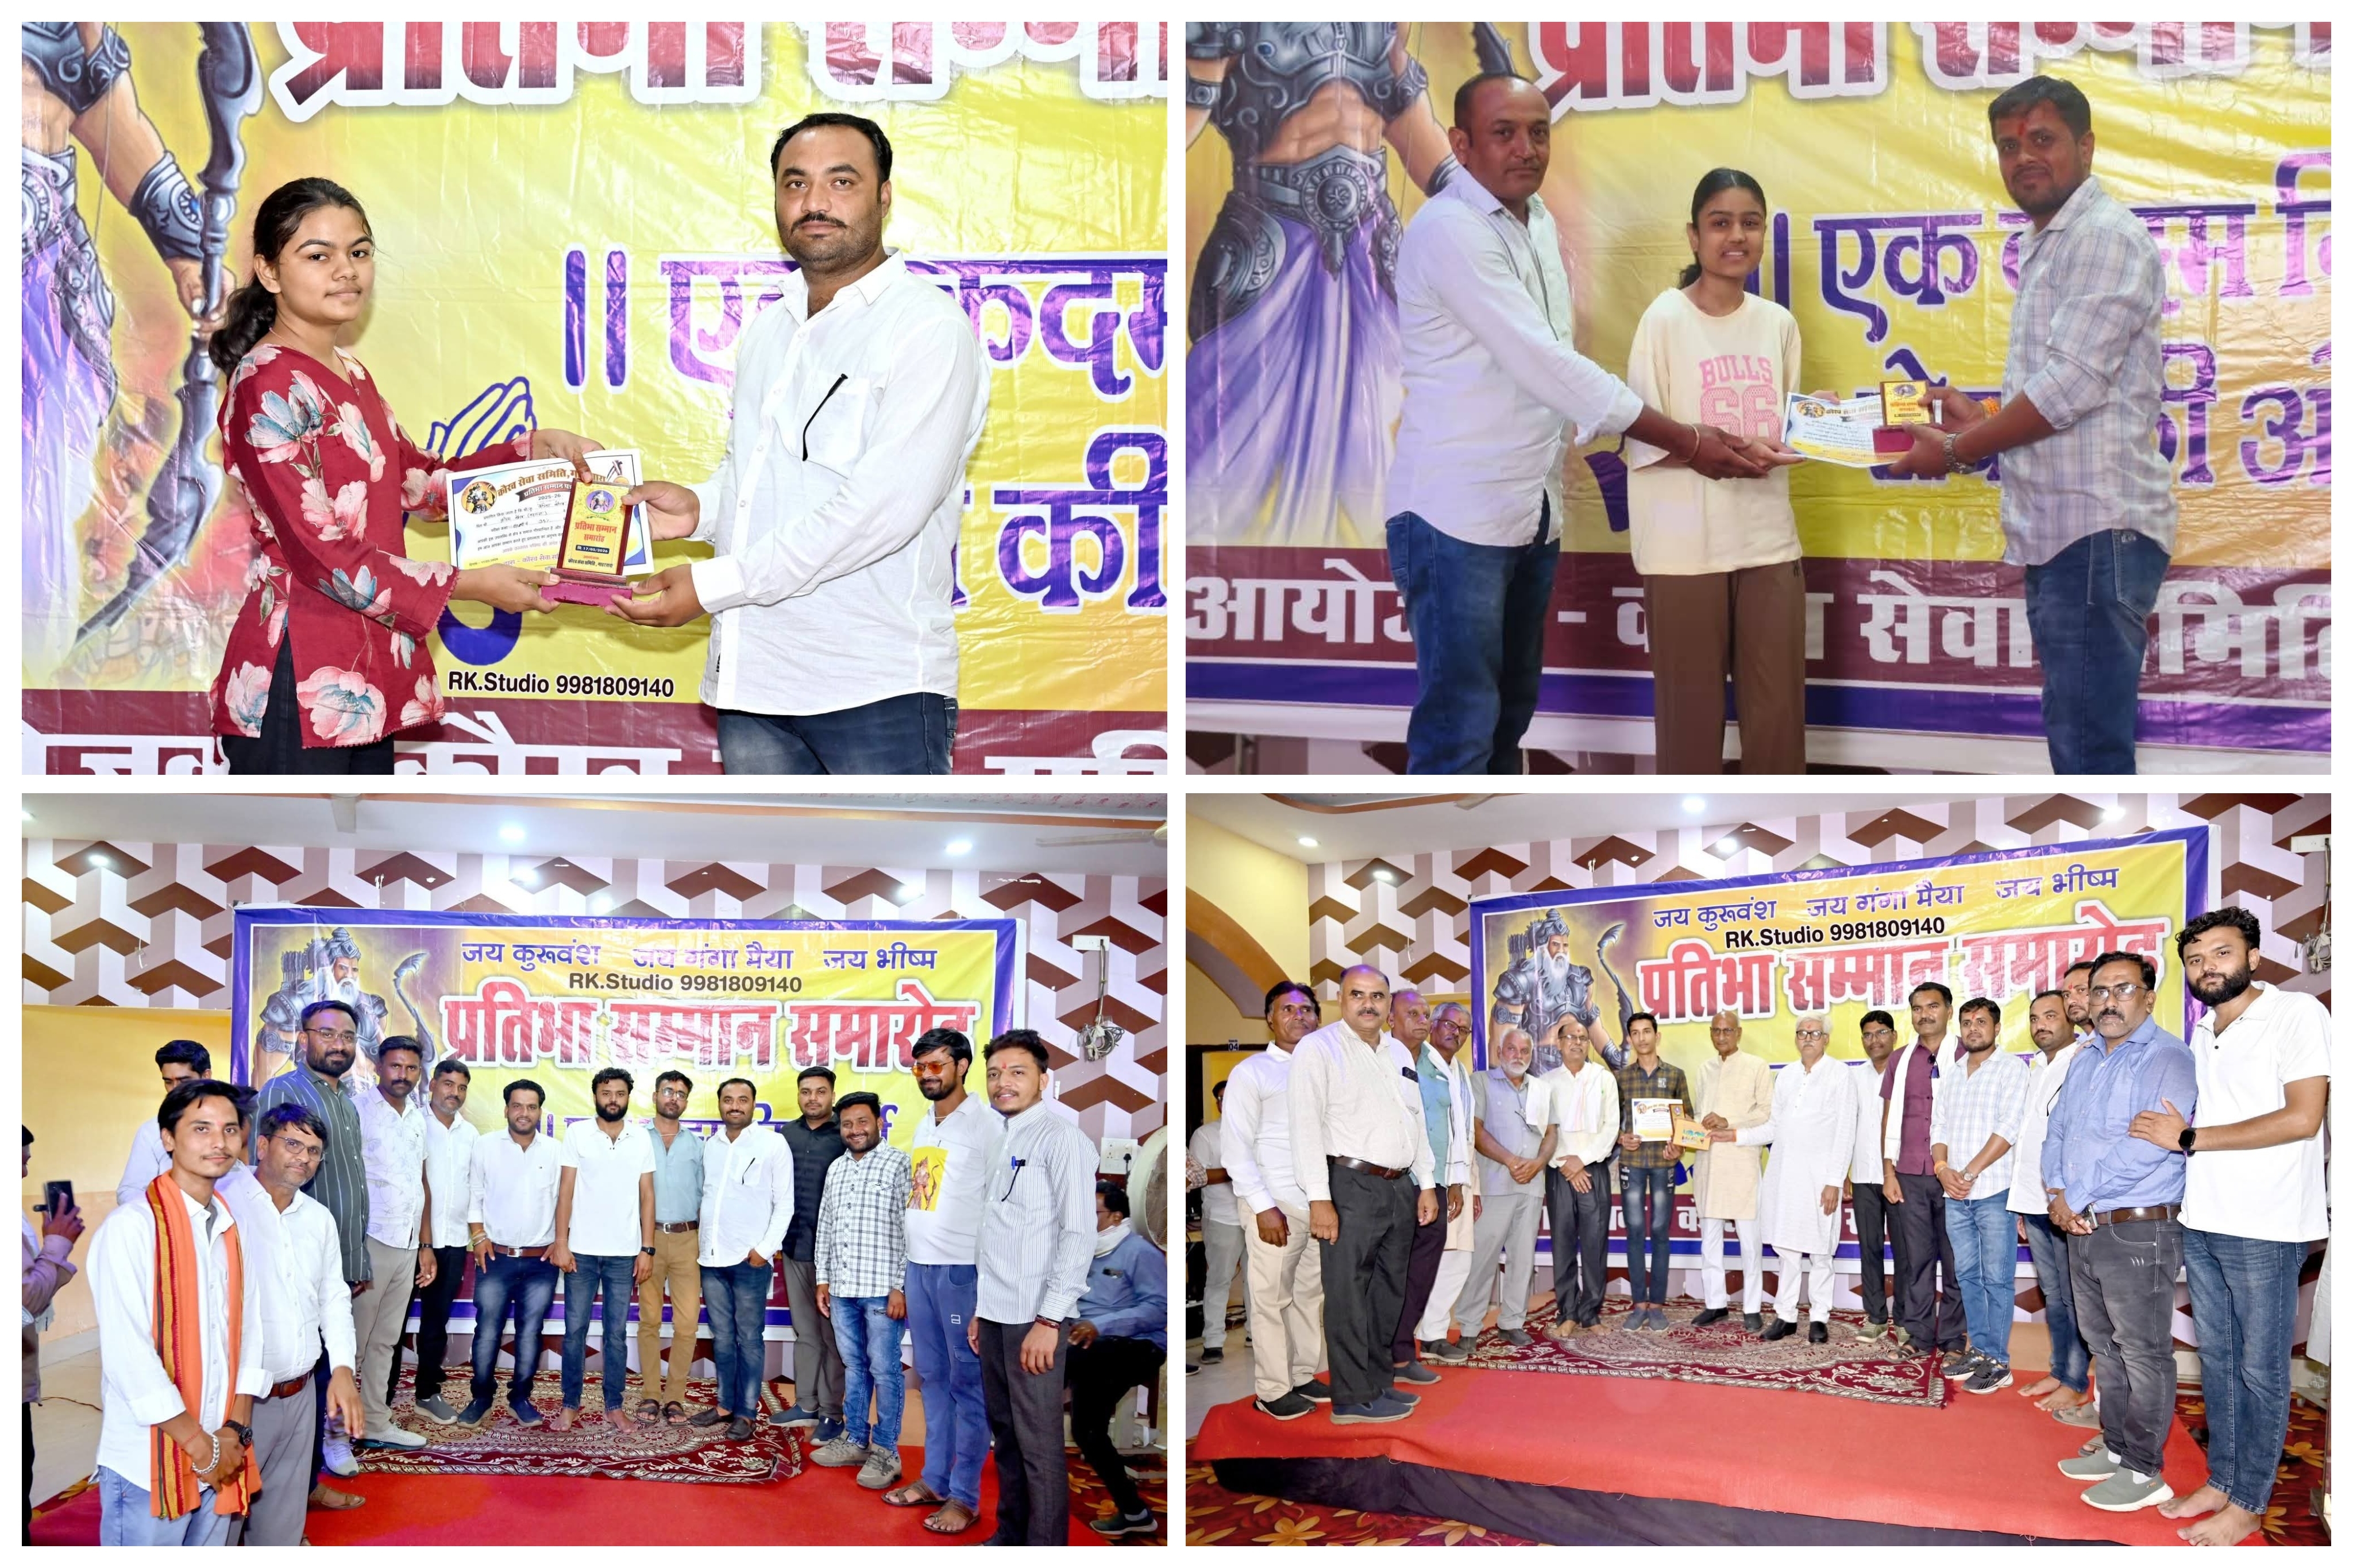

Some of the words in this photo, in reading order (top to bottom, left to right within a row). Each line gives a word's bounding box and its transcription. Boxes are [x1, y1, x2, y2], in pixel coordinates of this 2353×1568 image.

[1814, 214, 1981, 343] एक
[1699, 354, 1773, 389] BULLS
[1700, 384, 1781, 441] 66
[497, 481, 516, 497] कौरव
[518, 475, 534, 487] सेवा
[574, 521, 595, 531] प्रतिभा
[596, 524, 617, 534] सम्मान
[1857, 570, 2032, 668] सेवा
[1653, 908, 1690, 928] जय
[1807, 897, 1848, 917] जय
[1856, 888, 1909, 913] गंगा
[1916, 880, 1965, 906] मैया
[1996, 876, 2042, 898] जय
[2053, 864, 2119, 894] भीष्म
[462, 943, 505, 963] जय
[632, 948, 677, 968] जय
[823, 950, 868, 969] जय
[876, 943, 938, 969] भीष्म
[1641, 943, 1774, 1019] प्रतिभा
[1786, 941, 1948, 1011] सम्मान
[445, 982, 597, 1063] प्रतिभा
[610, 1003, 777, 1065] सम्मान
